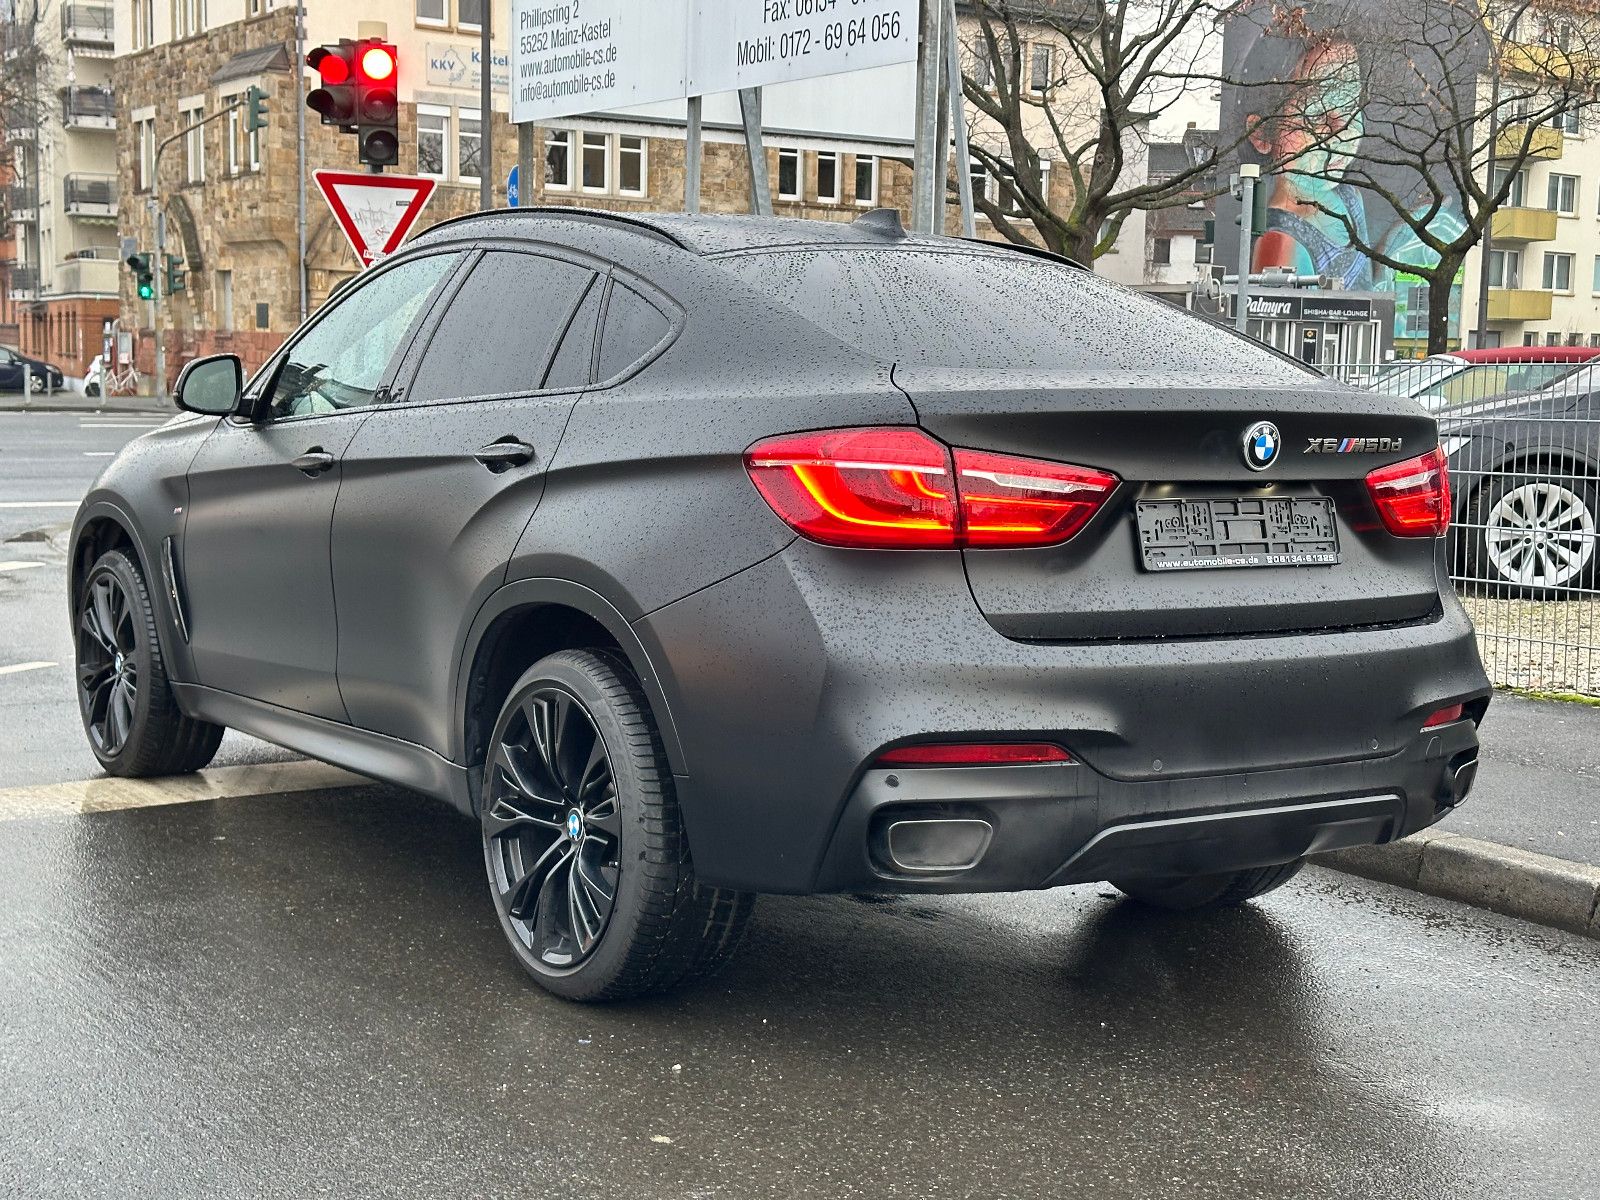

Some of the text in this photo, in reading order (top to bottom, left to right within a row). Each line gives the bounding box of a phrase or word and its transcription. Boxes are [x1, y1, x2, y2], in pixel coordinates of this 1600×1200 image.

[520, 0, 579, 30] Phillipsring 2
[763, 0, 790, 23] Fax:
[520, 17, 611, 55] 55252 Mainz-Kastel
[737, 36, 775, 66] Mobil:
[780, 28, 811, 59] 0172
[825, 22, 843, 51] 69
[847, 17, 866, 47] 64
[871, 10, 900, 42] 056
[431, 59, 455, 70] KKV
[520, 42, 617, 79] www.automobile-cs.de
[520, 69, 615, 103] info@automobile-cs.de
[1253, 427, 1278, 440] BMW
[1303, 437, 1338, 454] X6
